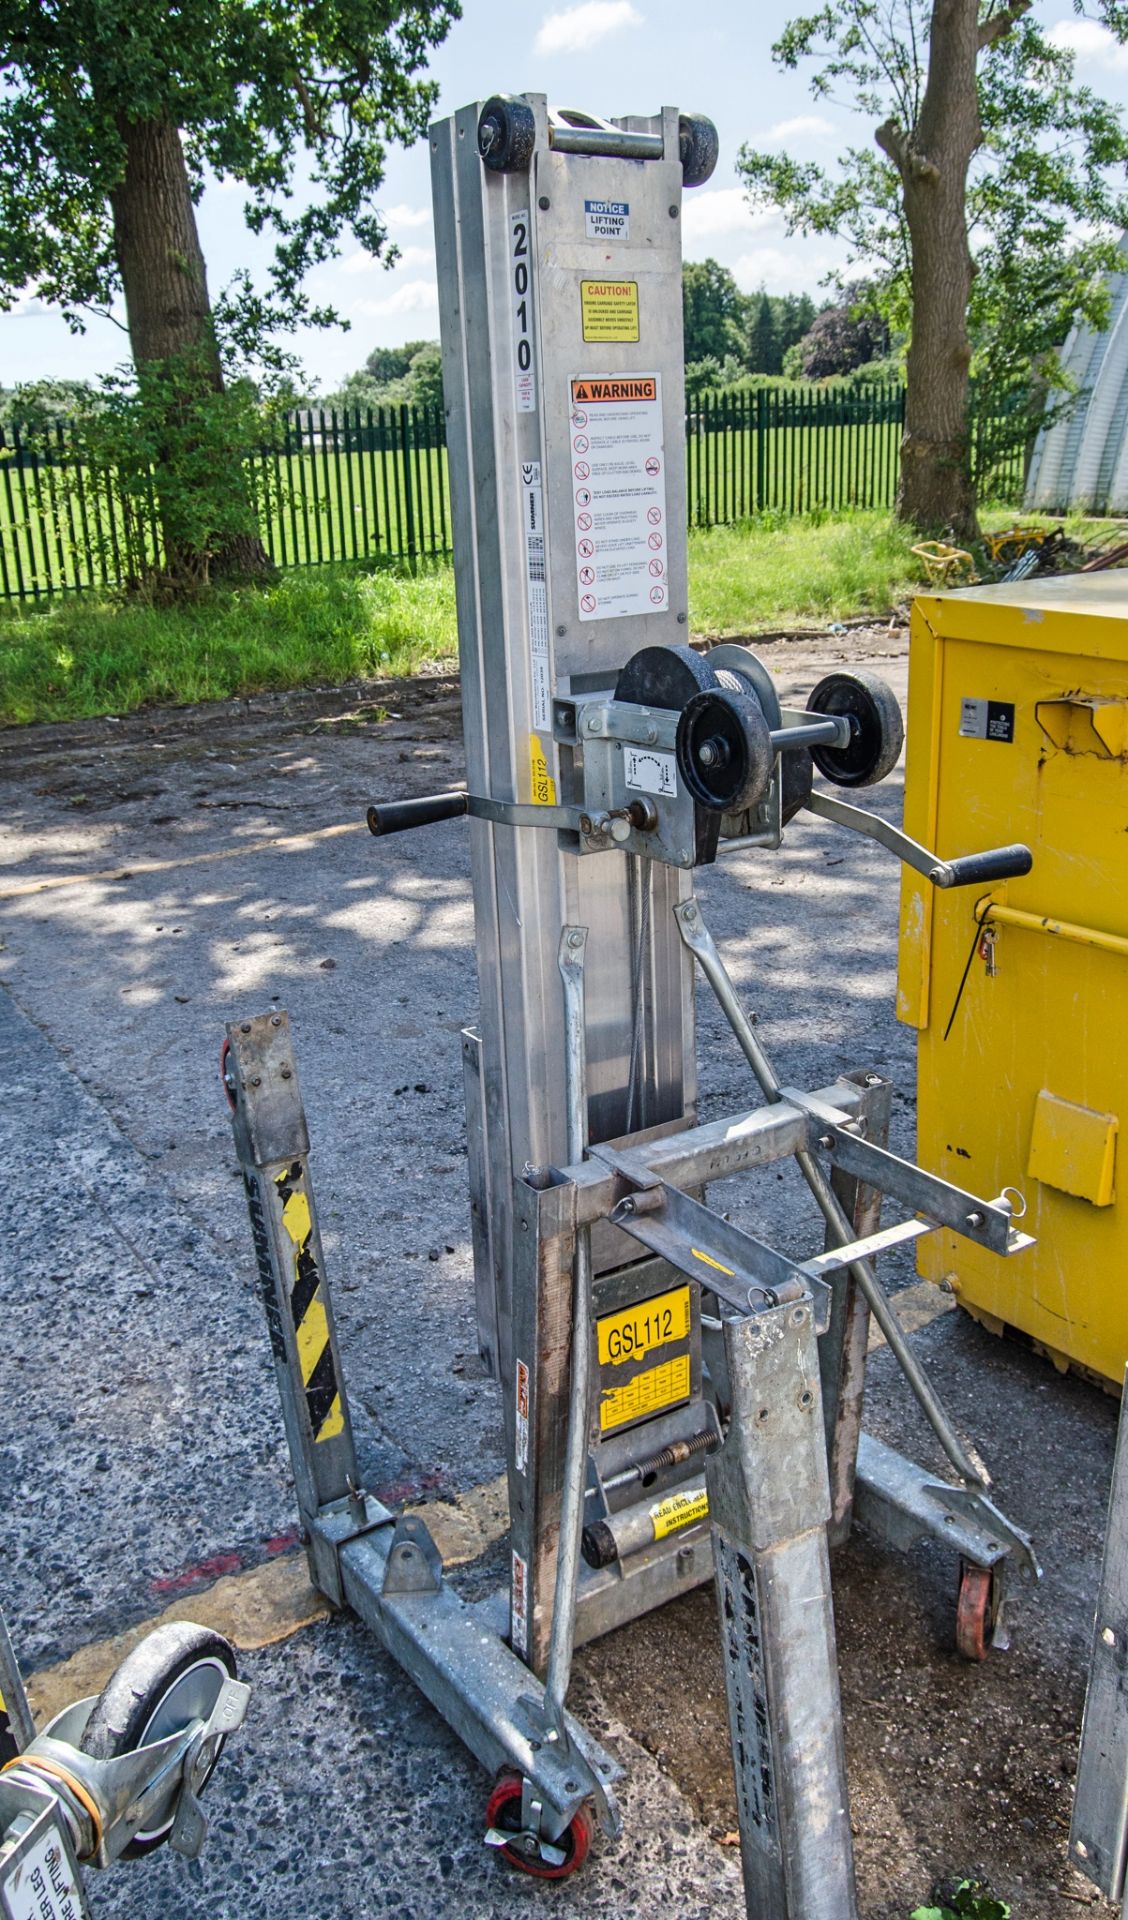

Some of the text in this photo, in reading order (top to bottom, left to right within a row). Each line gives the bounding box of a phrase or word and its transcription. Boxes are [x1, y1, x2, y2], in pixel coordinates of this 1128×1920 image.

[590, 202, 625, 214] NOTICE
[591, 216, 625, 226] LIFTING
[594, 226, 621, 235] POINT
[588, 286, 631, 296] CAUTION!
[591, 383, 653, 399] WARNING
[537, 758, 549, 802] GSL112
[607, 1309, 673, 1359] GSL112
[665, 1502, 709, 1527] INSTRUCTION
[30, 1866, 46, 1900] LEG
[45, 1848, 70, 1904] LIFTING
